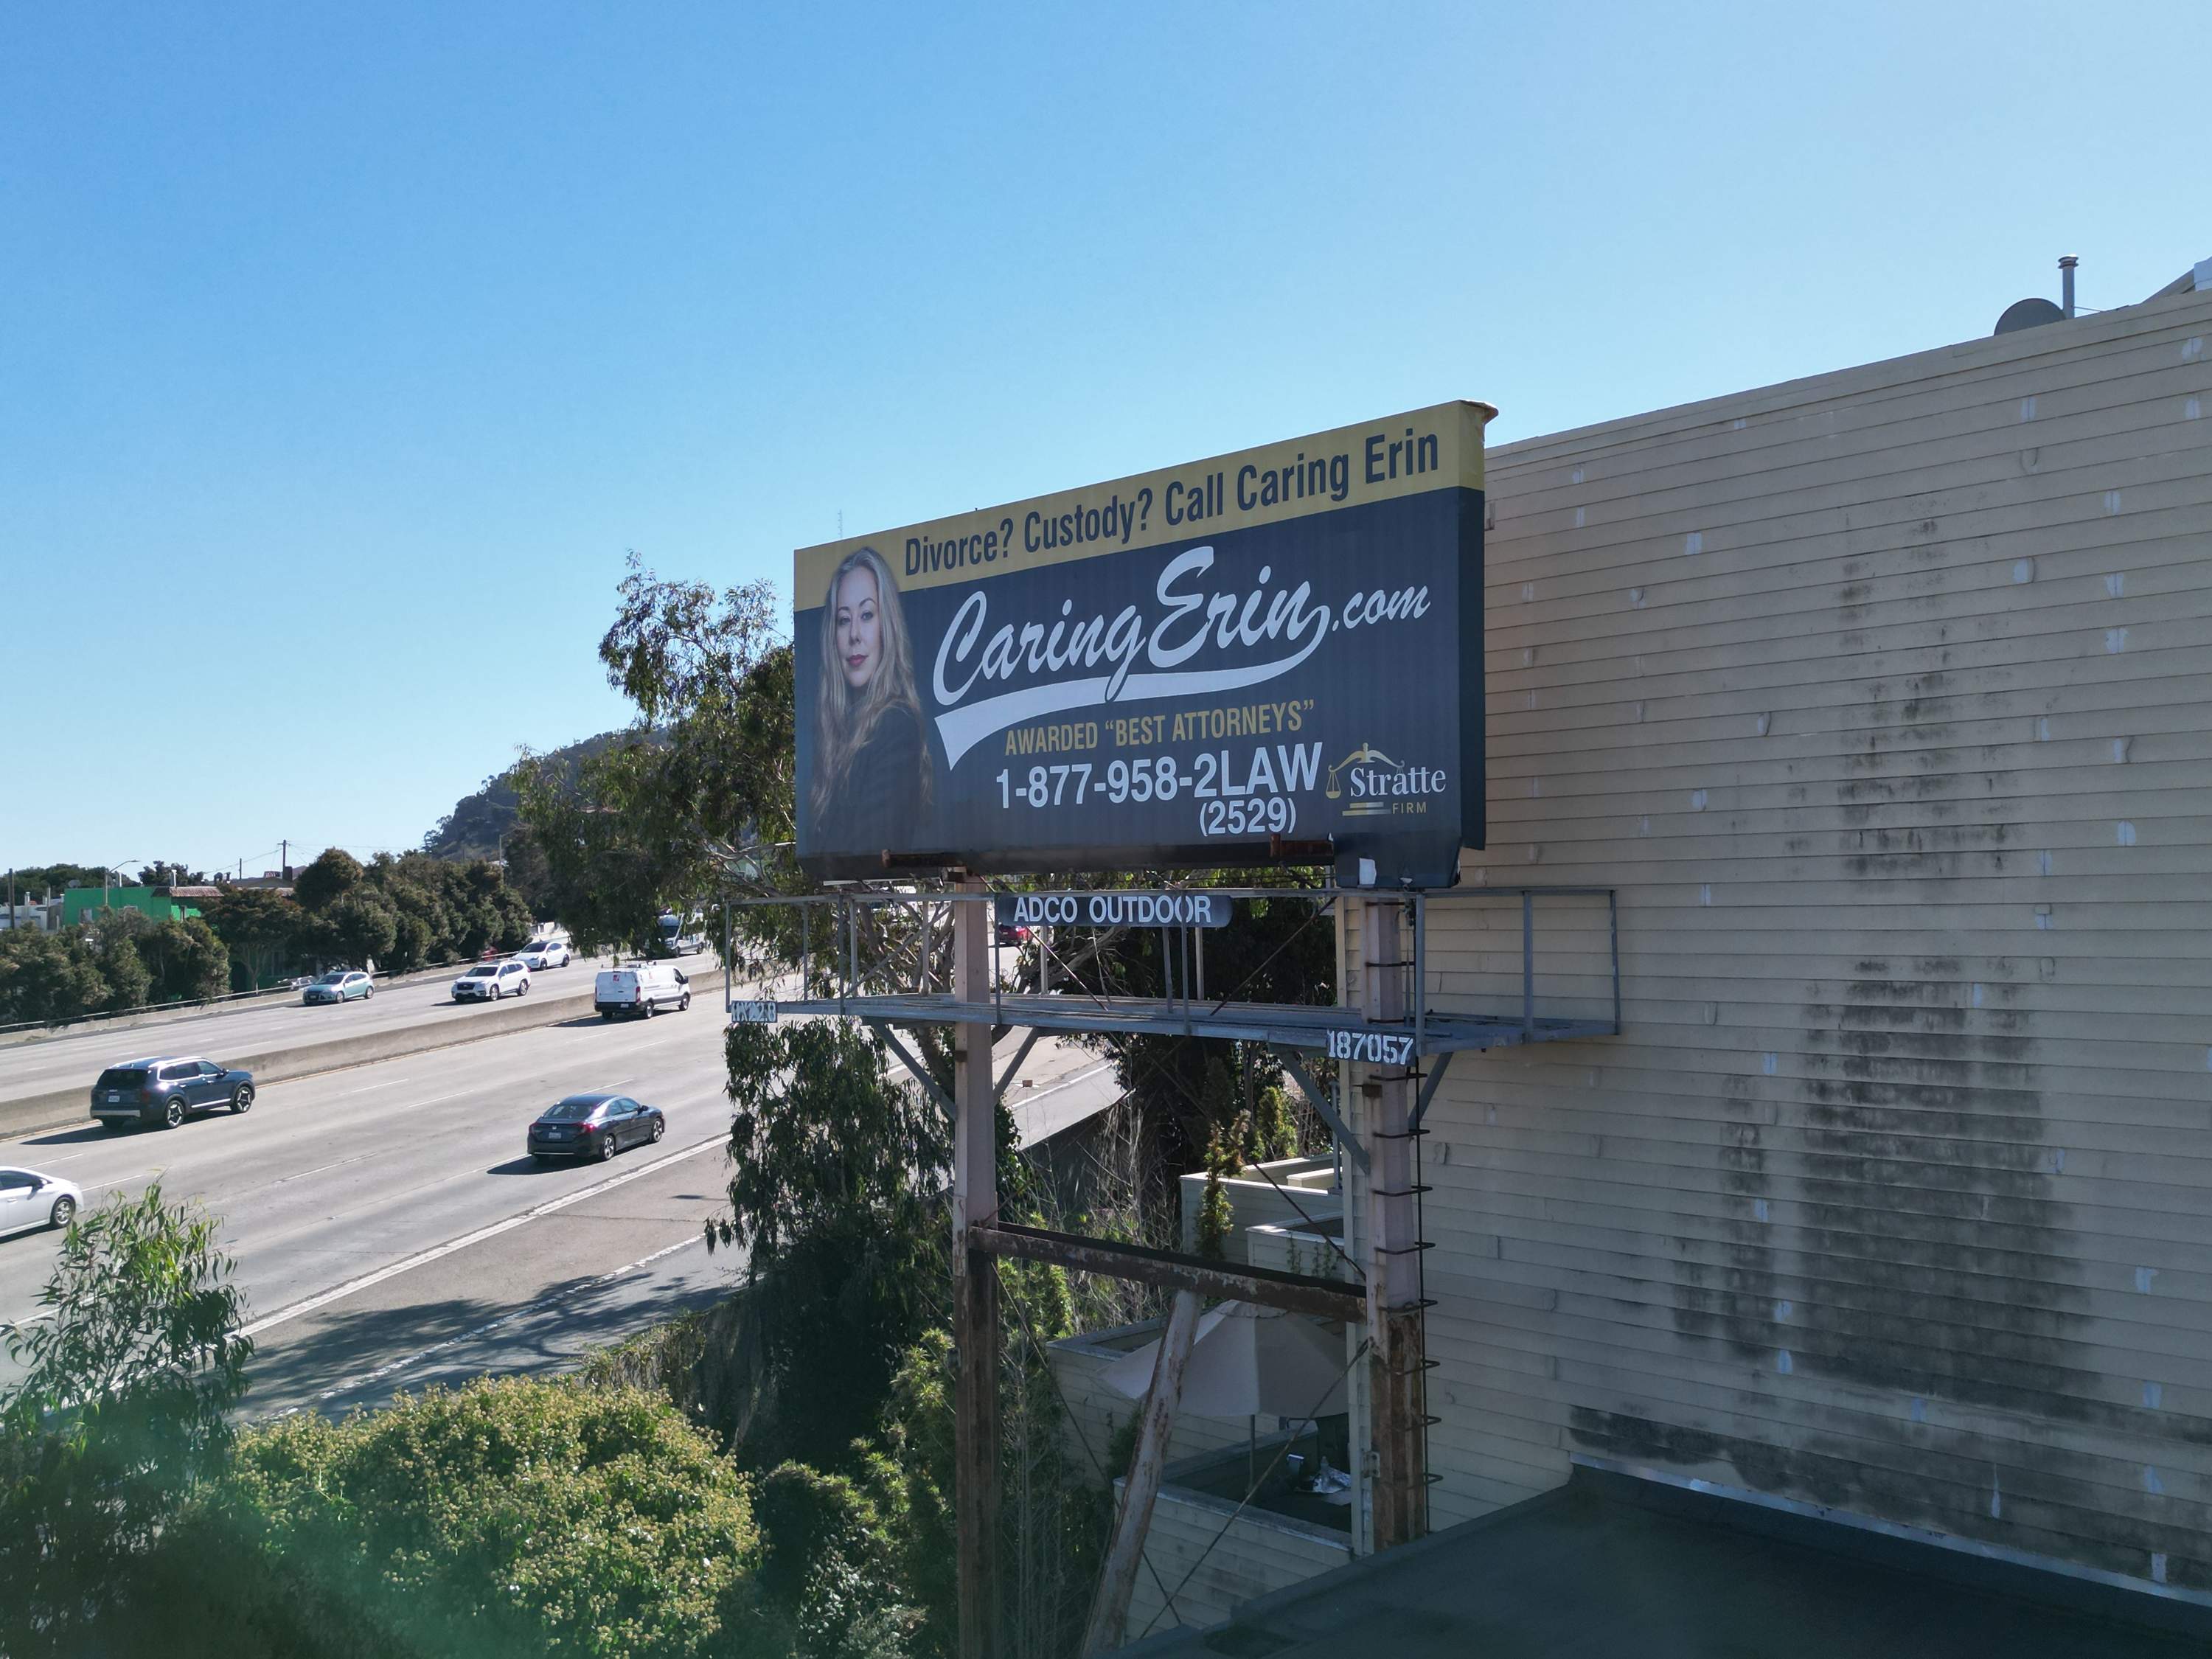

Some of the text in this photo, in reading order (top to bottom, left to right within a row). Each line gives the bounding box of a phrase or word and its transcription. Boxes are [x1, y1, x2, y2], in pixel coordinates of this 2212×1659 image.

[905, 428, 1439, 577] Divorce? Custody? Call Caring Erin
[933, 546, 1431, 703] CaringErin.com
[1005, 721, 1098, 756] AWARDED
[995, 742, 1323, 809] 1-877-958-2LAW
[1350, 766, 1447, 798] Stratte
[1199, 796, 1296, 837] (2529)
[1392, 801, 1427, 814] FIRM
[1014, 894, 1211, 923] ADCO OUTDOOR
[1327, 1029, 1414, 1065] 187057
